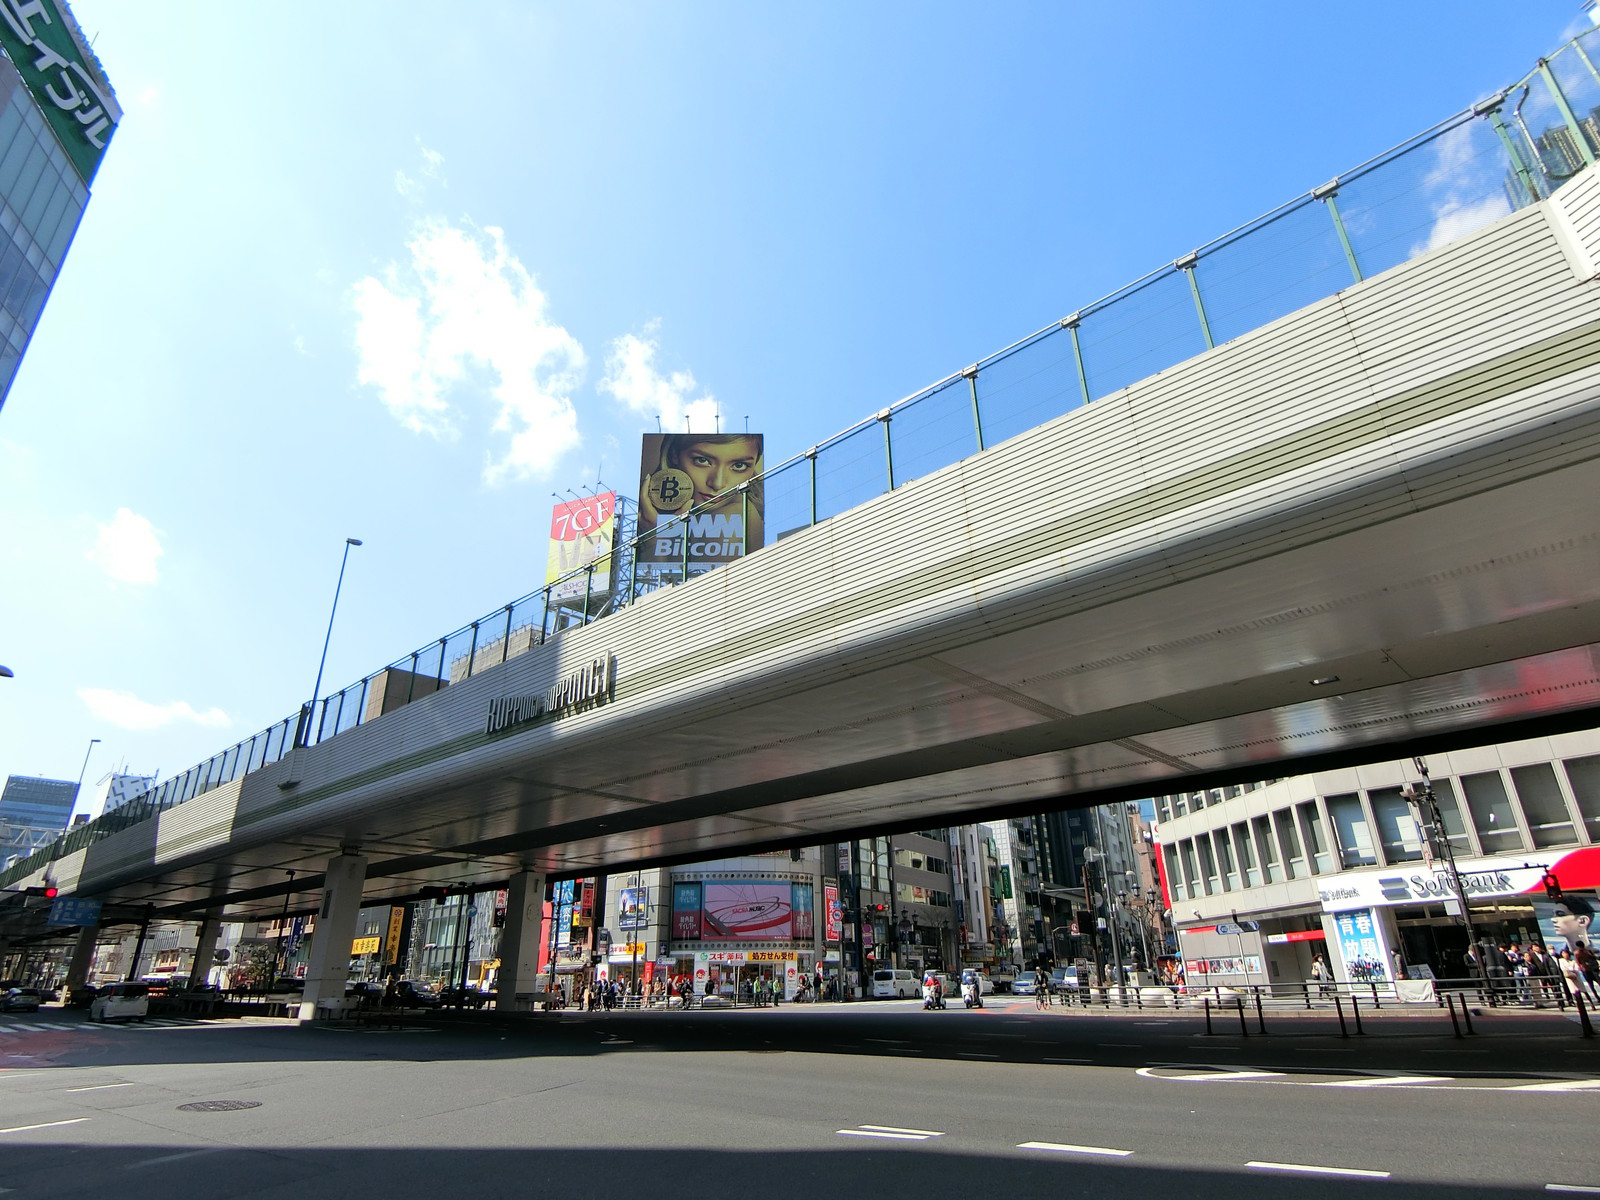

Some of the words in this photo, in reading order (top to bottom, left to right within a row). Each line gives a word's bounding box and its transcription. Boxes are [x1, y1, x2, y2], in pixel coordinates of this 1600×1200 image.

[656, 513, 744, 538] DMM
[654, 538, 746, 557] Bitcoin
[544, 650, 610, 713] ROPPONGI
[484, 695, 540, 734] ROPPONGI
[1410, 867, 1515, 894] SoftBank
[1338, 912, 1371, 936] 青春
[709, 952, 744, 960] スギ薬局
[752, 952, 794, 961] 処方せん受付
